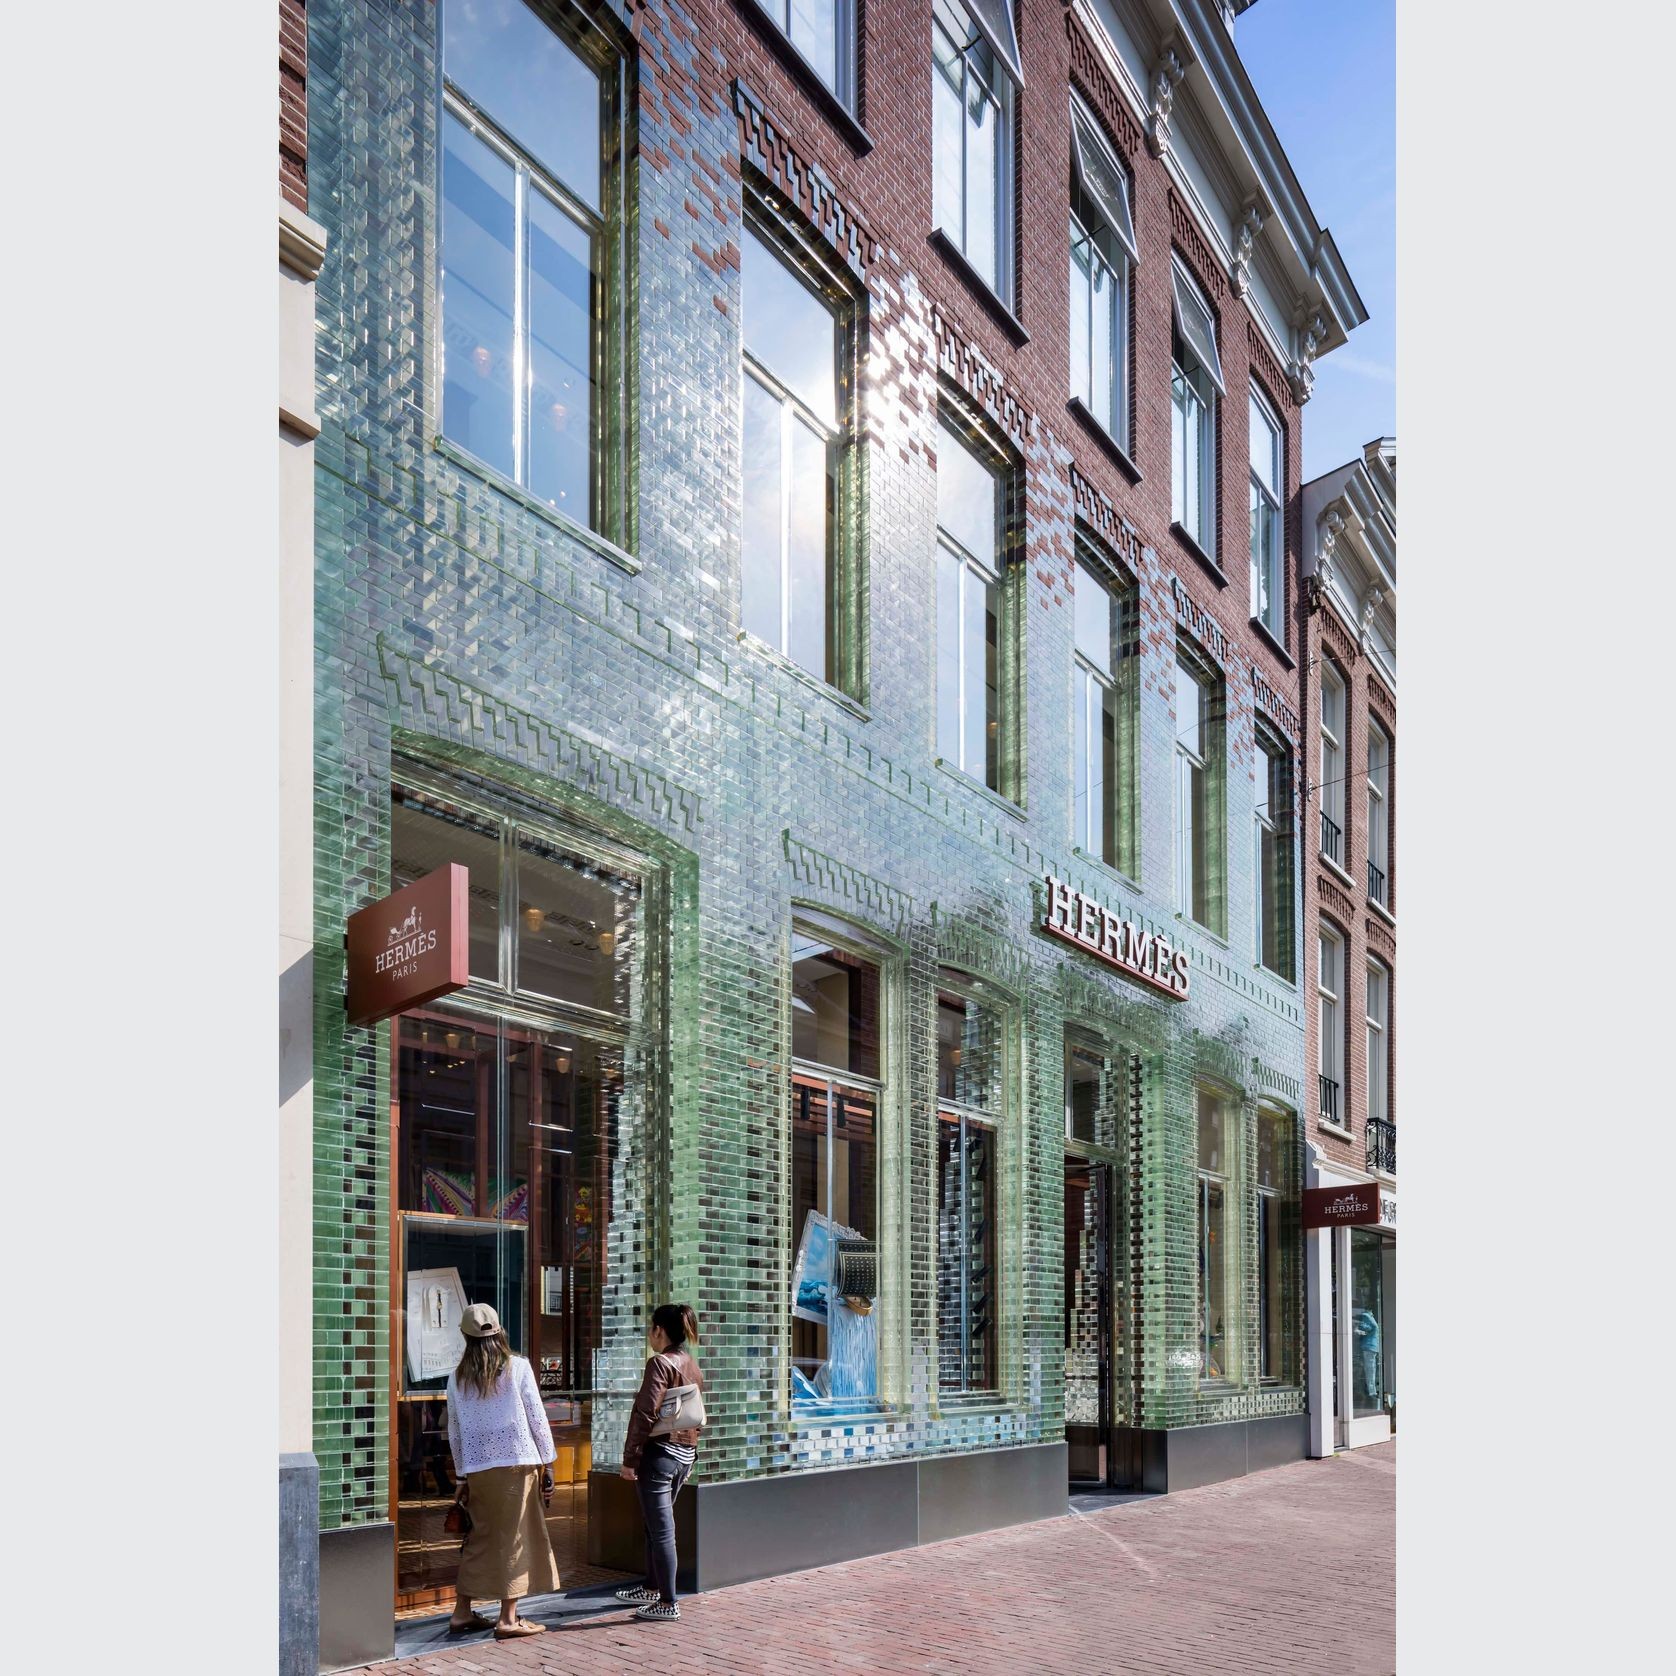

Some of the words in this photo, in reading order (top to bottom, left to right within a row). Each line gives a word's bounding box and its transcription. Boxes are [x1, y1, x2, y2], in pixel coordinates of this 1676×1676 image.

[375, 929, 437, 974] HERMÈS
[1045, 876, 1190, 995] HERMÈS
[392, 961, 418, 982] PARIS
